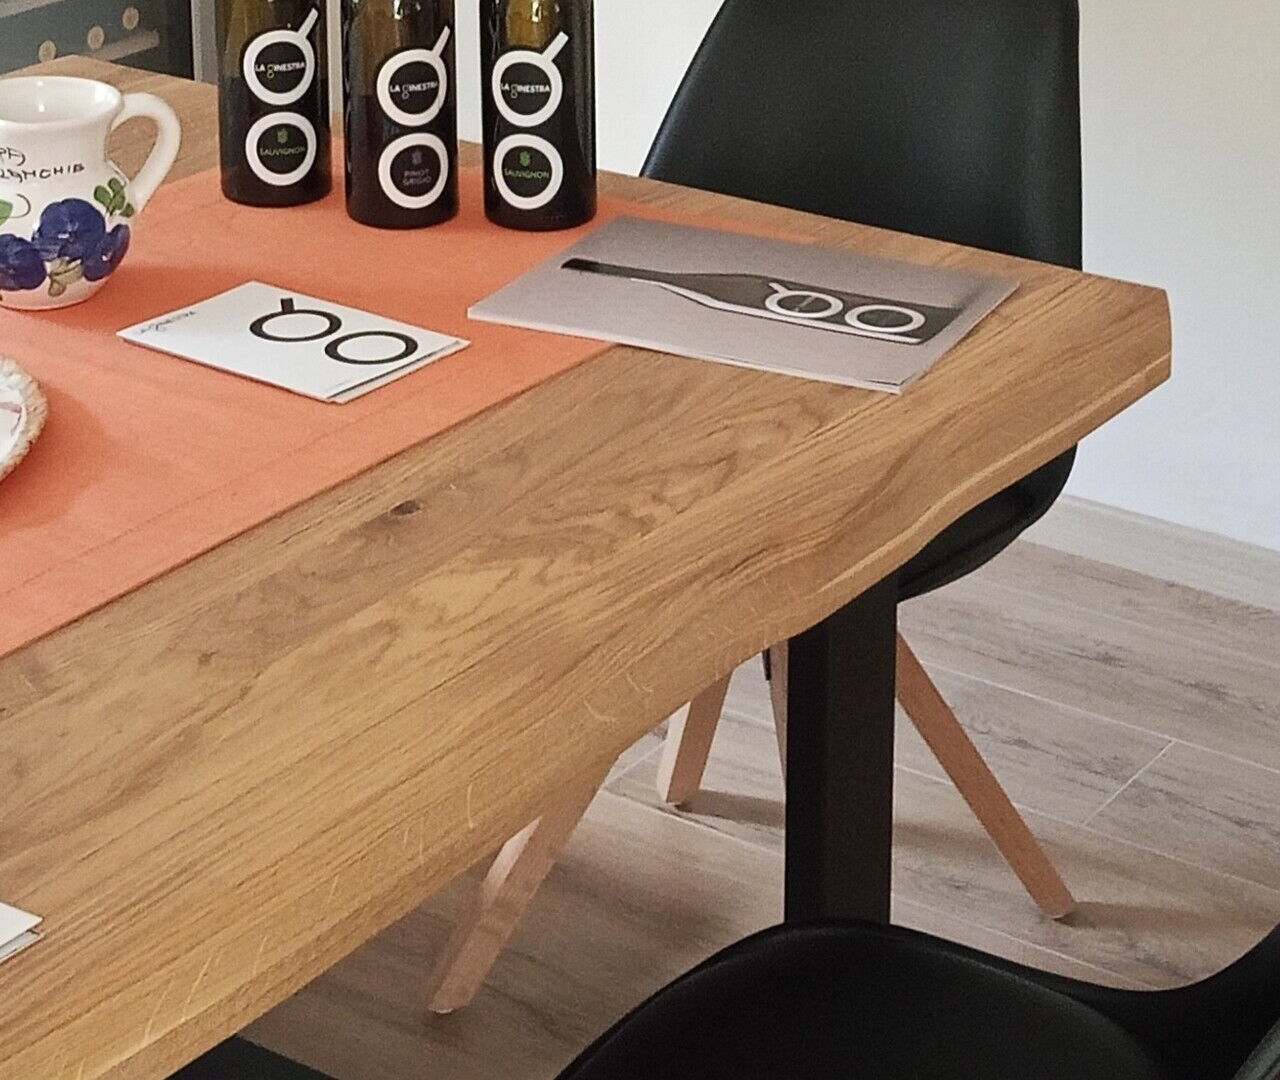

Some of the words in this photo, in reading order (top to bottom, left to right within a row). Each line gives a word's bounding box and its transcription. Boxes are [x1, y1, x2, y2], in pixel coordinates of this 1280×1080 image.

[255, 64, 266, 72] LA
[389, 84, 400, 92] LA
[501, 82, 510, 91] LA
[260, 146, 306, 156] SAUVIGNON
[504, 168, 550, 179] SAUVIGNON
